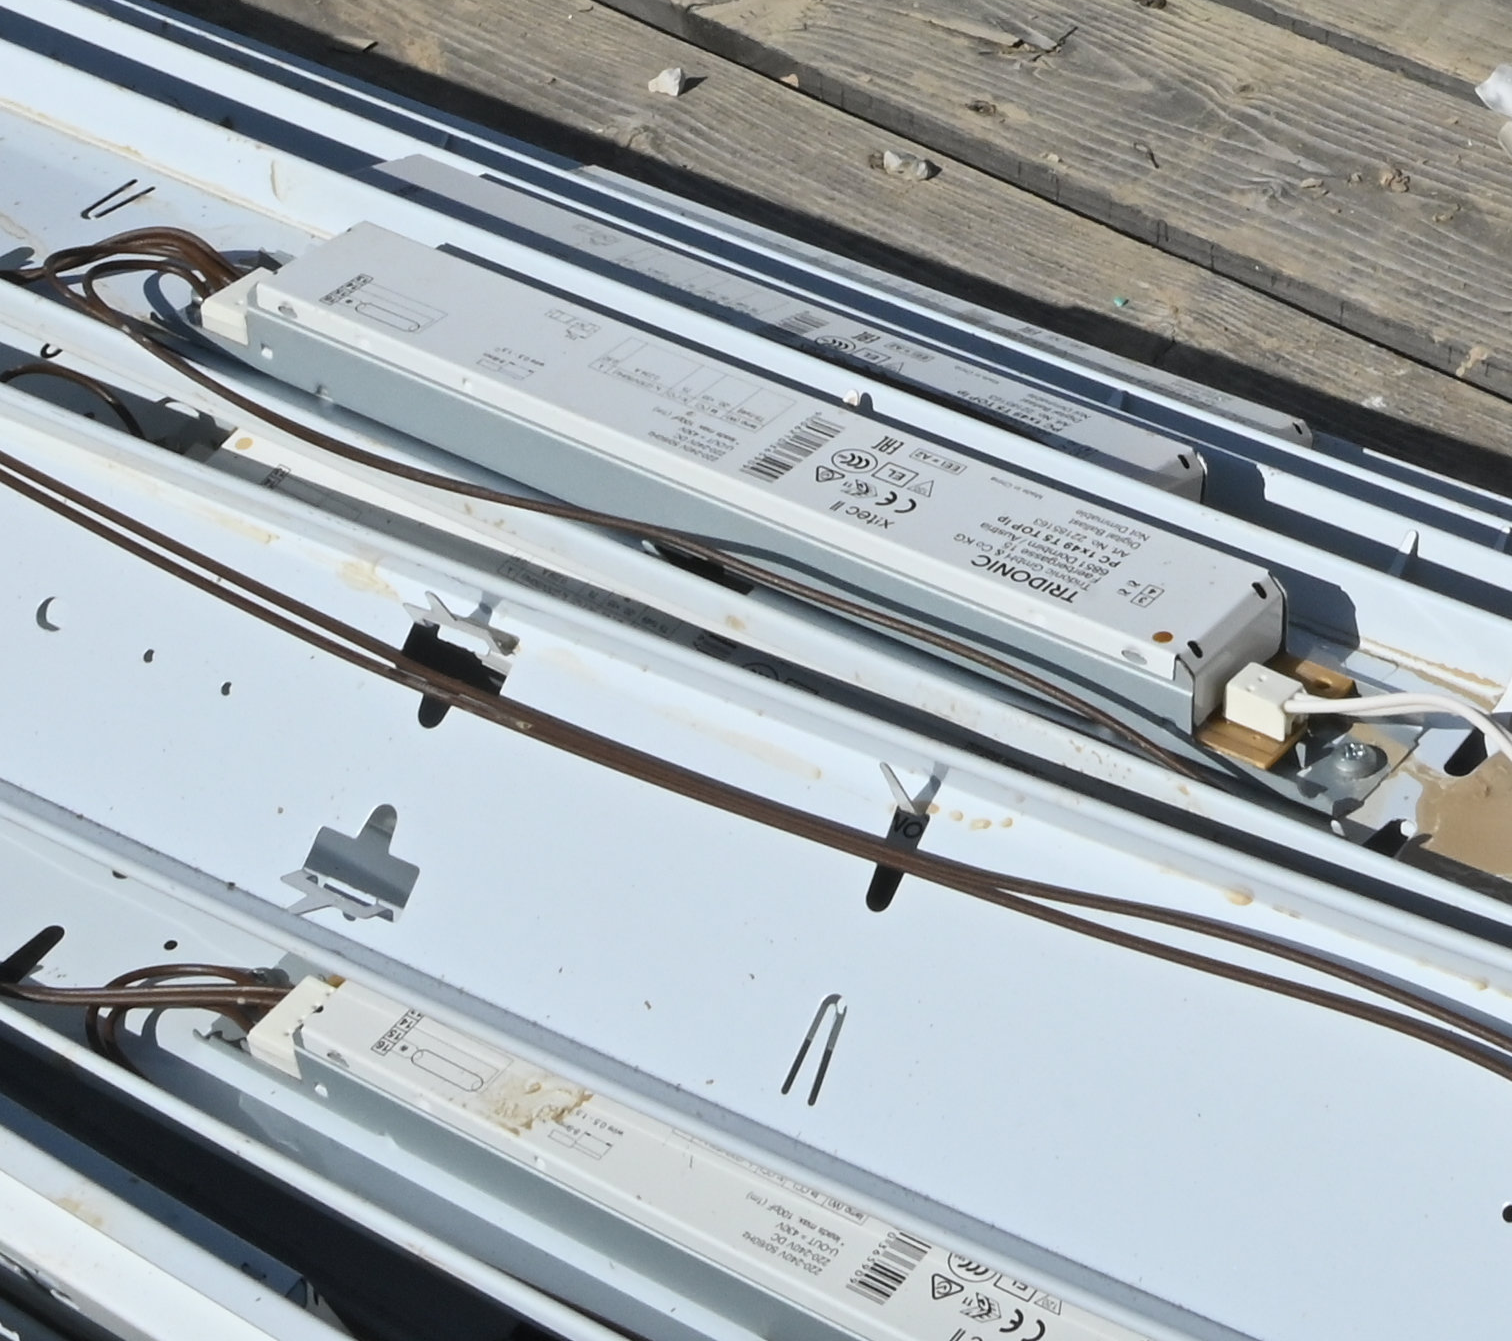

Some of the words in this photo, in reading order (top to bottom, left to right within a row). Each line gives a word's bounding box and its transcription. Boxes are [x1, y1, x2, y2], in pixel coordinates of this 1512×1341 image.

[881, 467, 906, 481] EL
[1010, 521, 1043, 537] TOP
[1066, 517, 1107, 536] Ballast
[1073, 508, 1129, 533] Dimmable
[951, 532, 975, 545] KG
[977, 521, 1021, 542] Austria
[1040, 533, 1062, 545] T5
[1105, 531, 1143, 549] Digital
[1127, 529, 1151, 541] Not
[972, 540, 995, 552] Co
[1001, 541, 1018, 550] 15
[1026, 540, 1079, 564] Dornbirn
[1061, 541, 1098, 559] 1x49
[1002, 551, 1045, 572] GmbH
[1017, 545, 1103, 584] Faerbergasse
[1076, 559, 1110, 576] 6851
[1097, 554, 1121, 567] PC
[968, 551, 1083, 605] TRIDONIC
[1046, 569, 1092, 591] Tridonic
[399, 1017, 413, 1028] 14
[387, 1029, 402, 1040] 15
[375, 1040, 390, 1051] 16
[775, 1220, 802, 1237] 430V
[739, 1230, 779, 1254] 50/60Hz
[770, 1232, 788, 1244] DC
[805, 1235, 841, 1256] U-OUT
[785, 1239, 831, 1266] 220-240V
[776, 1249, 822, 1276] 220-240V
